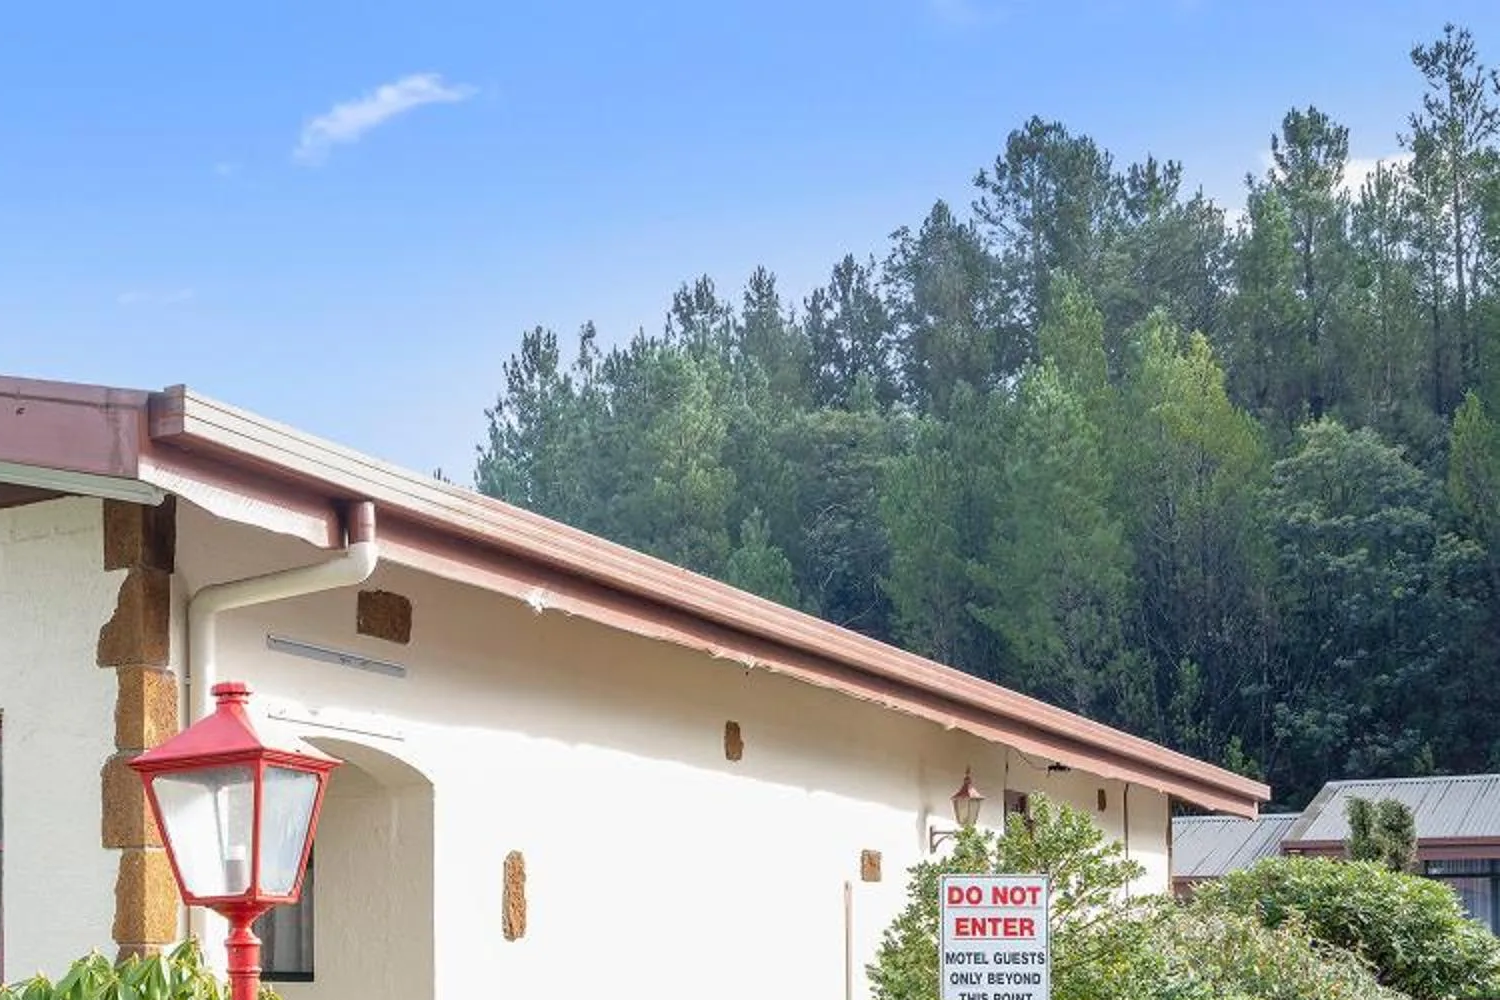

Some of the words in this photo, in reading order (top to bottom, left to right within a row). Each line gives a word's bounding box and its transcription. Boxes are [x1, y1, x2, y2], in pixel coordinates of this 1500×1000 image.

[947, 886, 982, 905] DO
[992, 886, 1041, 905] NOT
[955, 918, 1035, 936] ENTER
[946, 952, 989, 965] MOTEL
[994, 952, 1045, 964] GUESTS
[950, 973, 982, 985] ONLY
[988, 973, 1041, 985] BEYOND
